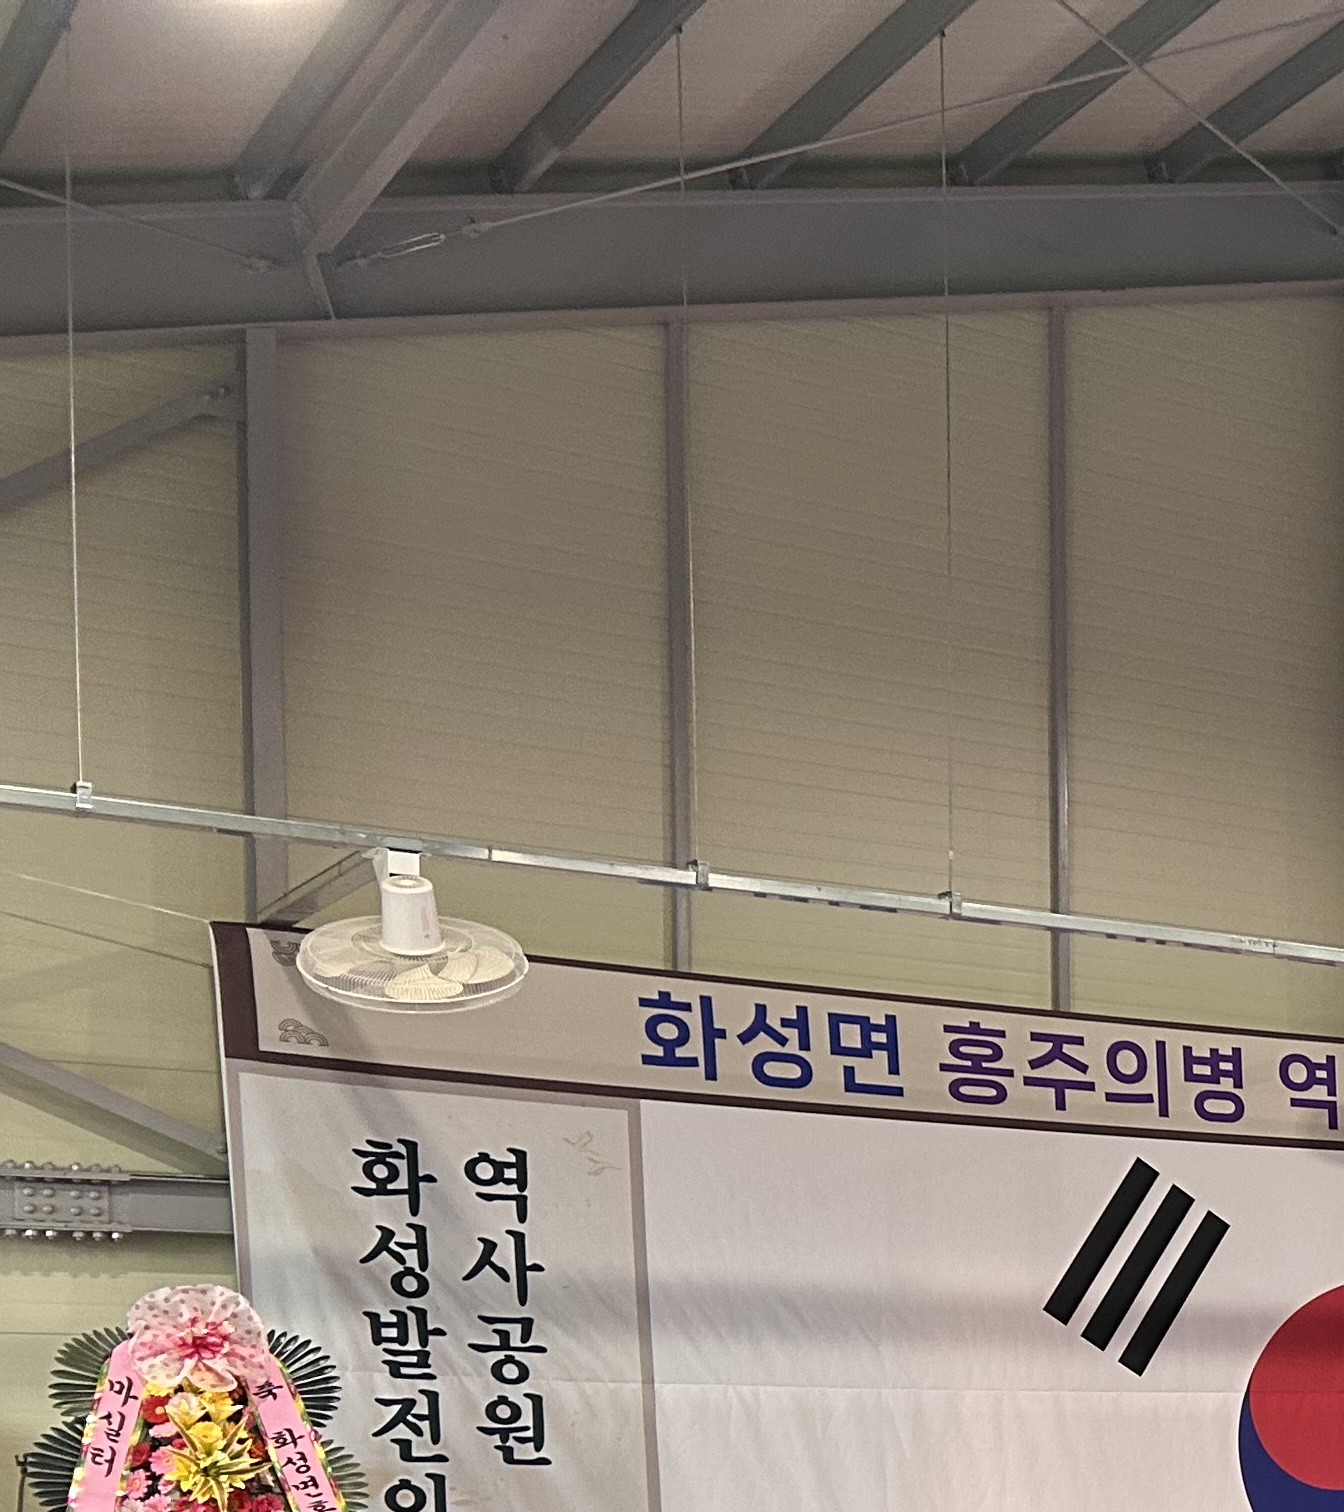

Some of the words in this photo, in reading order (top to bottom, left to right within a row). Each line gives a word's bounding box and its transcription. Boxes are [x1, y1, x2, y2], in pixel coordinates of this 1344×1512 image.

[638, 990, 904, 1098] 화성면
[939, 1020, 1246, 1124] 홍주의병
[462, 1147, 552, 1466] 역사공원
